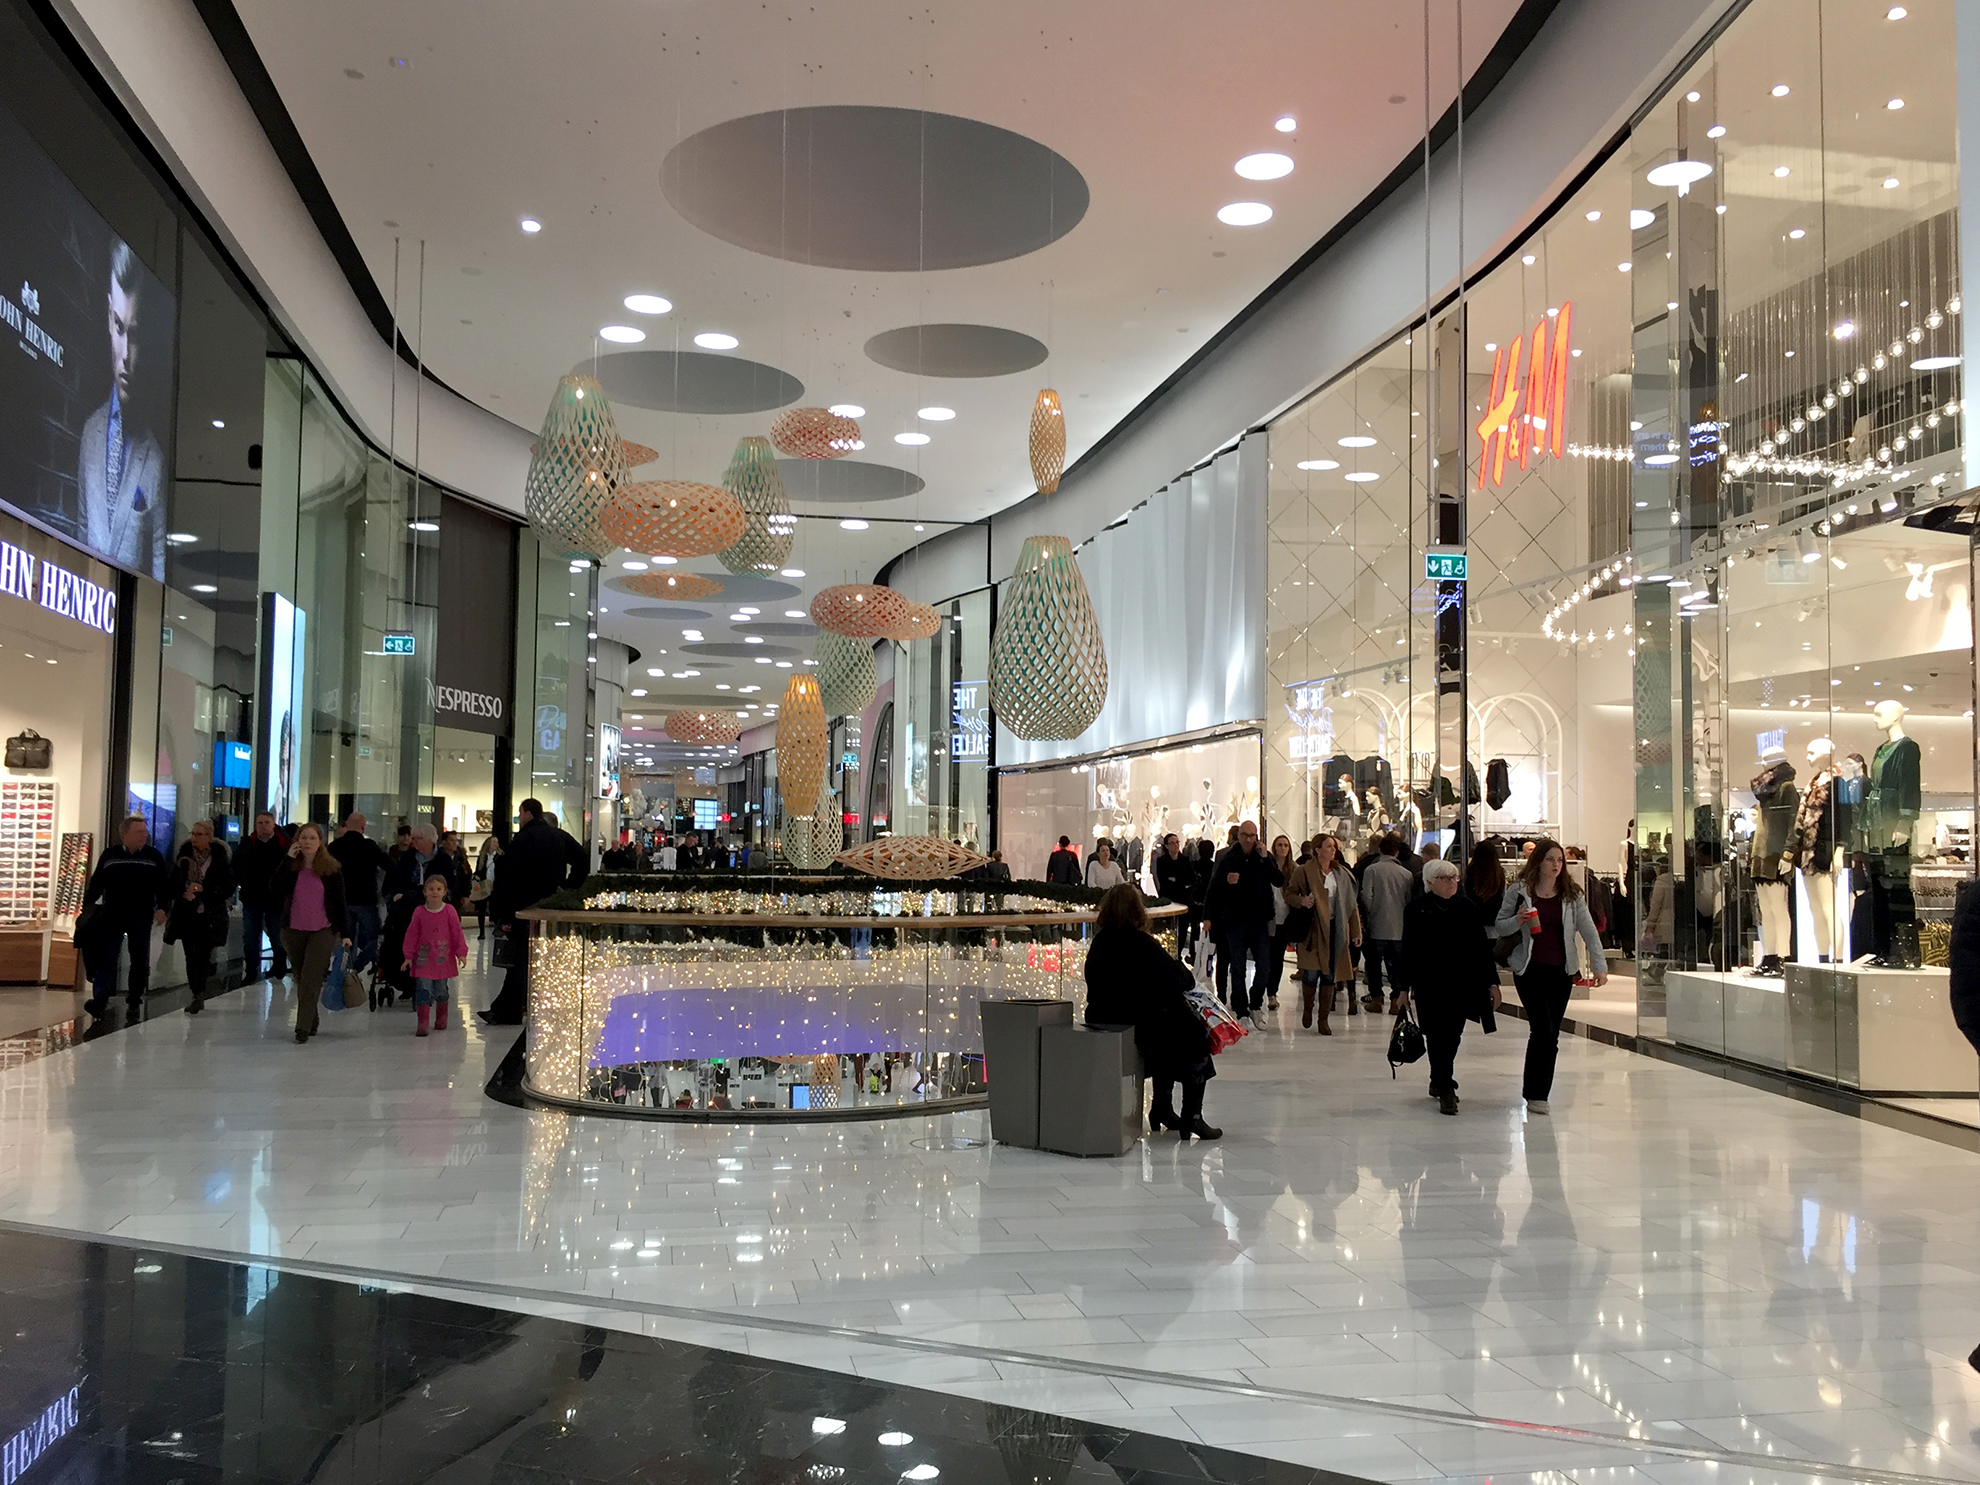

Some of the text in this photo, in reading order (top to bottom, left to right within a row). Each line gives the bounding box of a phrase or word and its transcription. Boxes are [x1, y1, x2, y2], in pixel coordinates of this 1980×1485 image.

[25, 317, 64, 368] HENRIC
[1476, 300, 1572, 490] H&M
[41, 560, 116, 635] HENRIC
[425, 677, 502, 719] NESPRESSO
